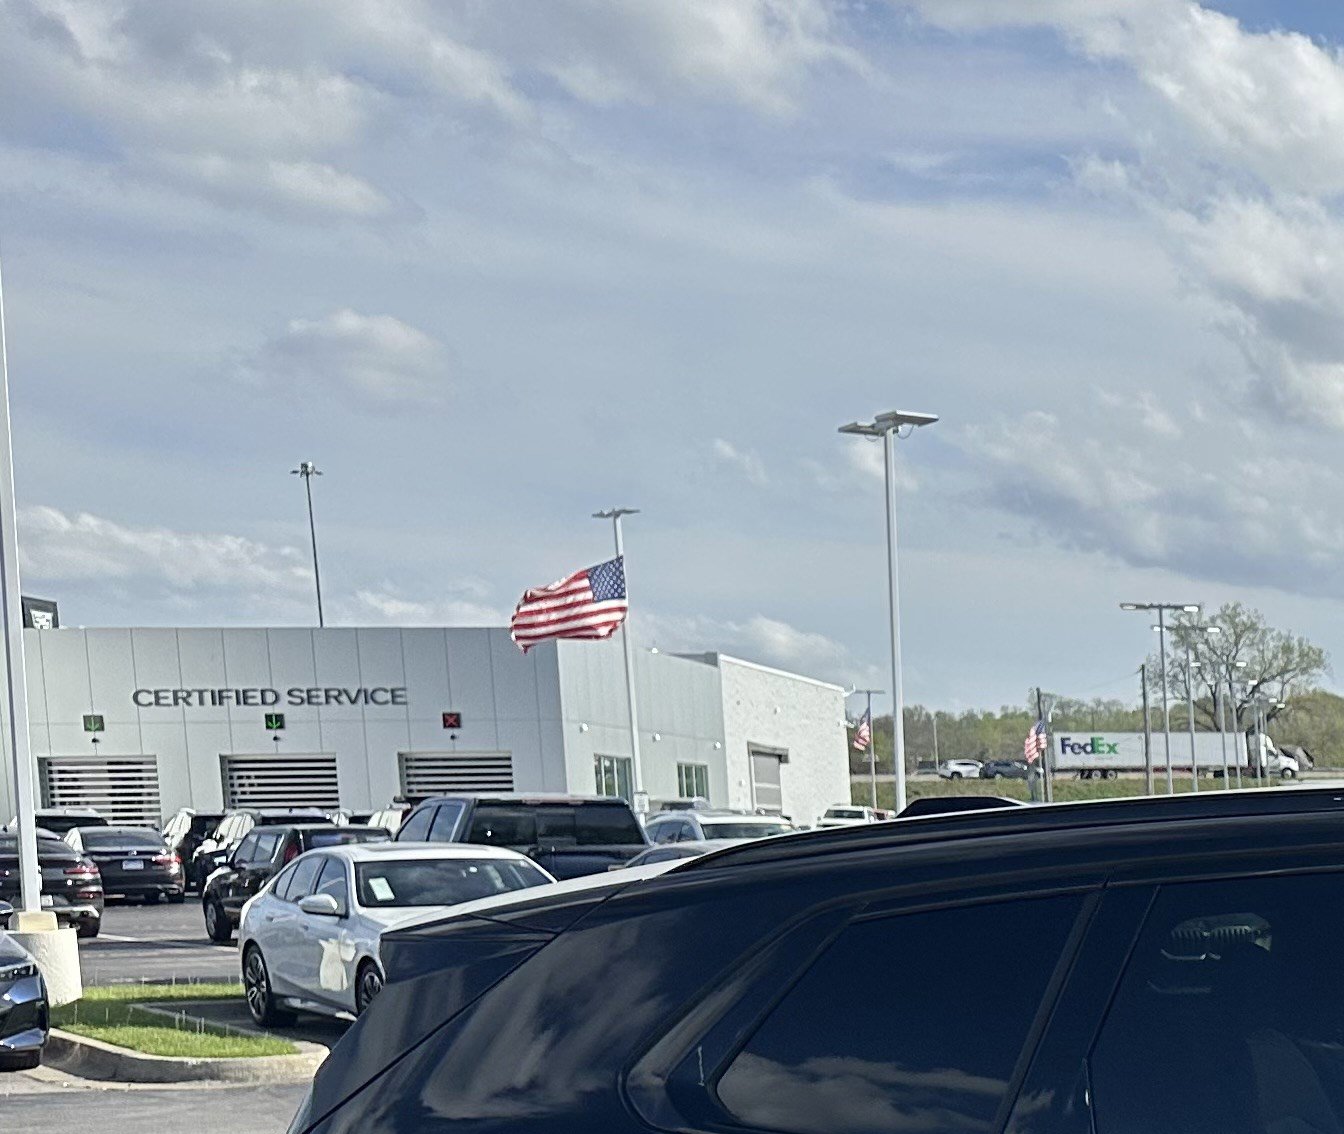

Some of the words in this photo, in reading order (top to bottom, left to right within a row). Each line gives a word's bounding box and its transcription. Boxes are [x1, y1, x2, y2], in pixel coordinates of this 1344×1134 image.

[132, 687, 281, 708] CERTIFIED
[286, 686, 409, 707] SERVICE
[1060, 736, 1120, 755] FedEx
